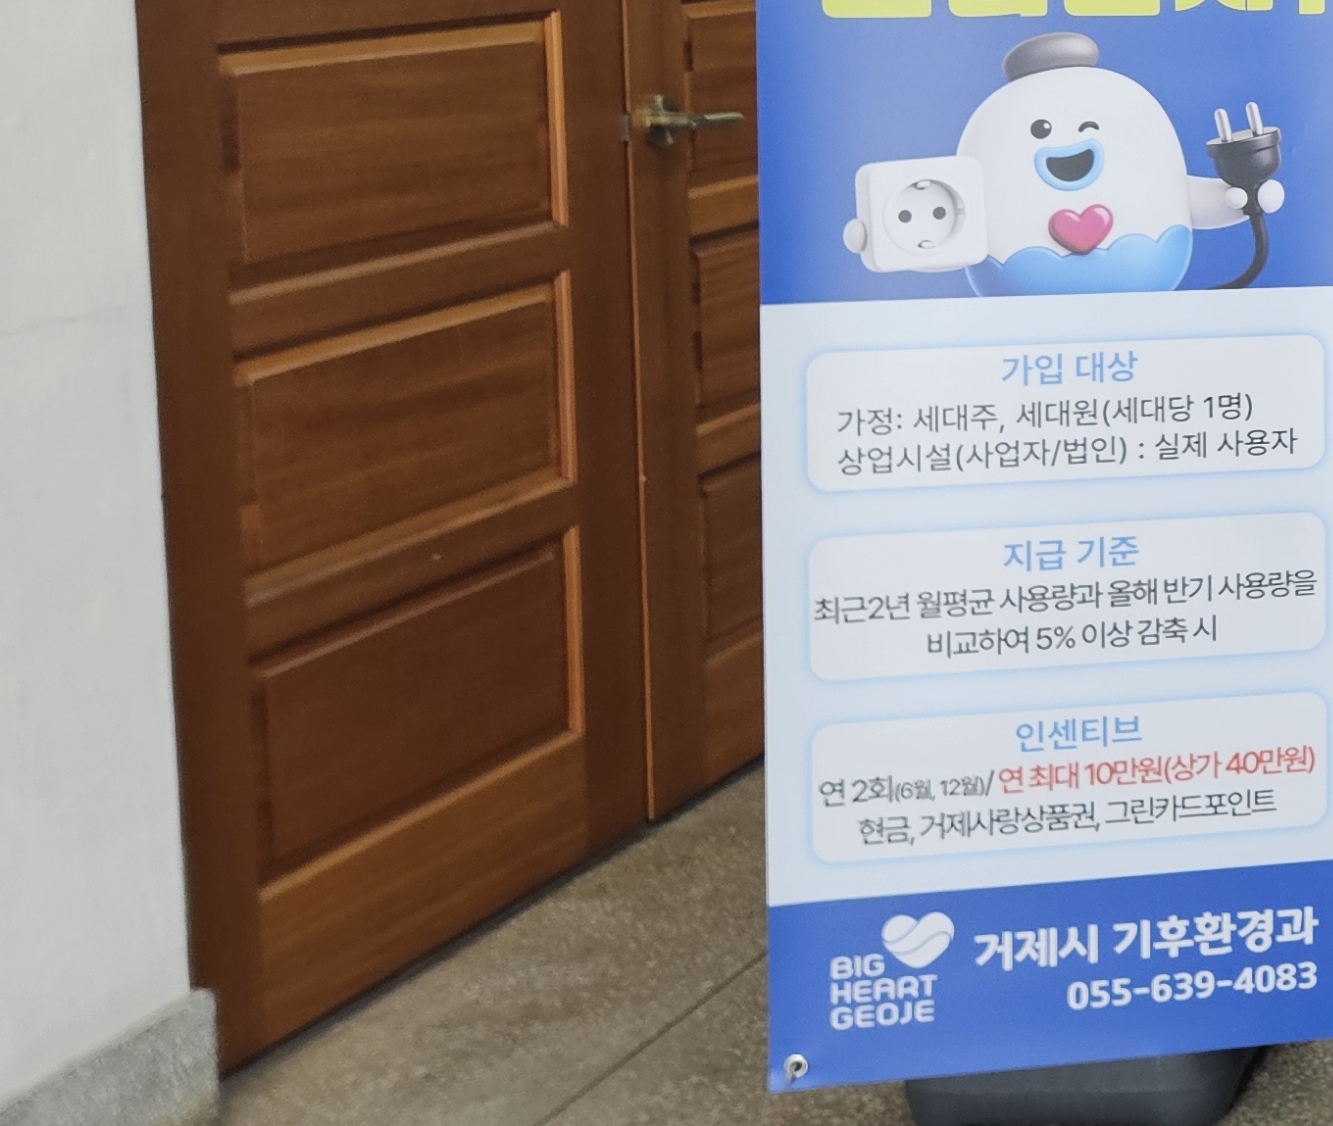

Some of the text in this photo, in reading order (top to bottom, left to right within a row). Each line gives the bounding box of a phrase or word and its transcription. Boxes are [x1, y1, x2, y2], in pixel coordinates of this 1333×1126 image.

[1002, 351, 1138, 386] 가입 대상
[838, 393, 1252, 436] 가정: 세대주, 세대원(세대당 1명)
[838, 436, 1126, 475] 상업시설(사업자/법인)
[1155, 432, 1206, 460] 실제
[1218, 428, 1297, 456] 사용자
[1004, 536, 1139, 572] 지급 기준
[813, 568, 1318, 625] 최근2년 월평균 사용량과 올해 반기 사용량을
[926, 614, 1219, 660] 비교하여 5% 이상 감축 시
[1016, 716, 1142, 752] 인센티브
[817, 776, 848, 808] 연
[998, 765, 1025, 795] 연
[1029, 760, 1080, 792] 최대
[1084, 754, 1224, 789] 10만원(상가
[1226, 745, 1316, 778] 40만원)
[857, 787, 1279, 848] 현금, 거제사랑상품권, 그린카드포인트
[974, 906, 1319, 971] 거제시 기후환경과
[829, 953, 886, 981] BIG
[1067, 961, 1317, 1010] 055-639-4083
[829, 974, 939, 1006] HEART
[829, 998, 936, 1032] GEOJE
